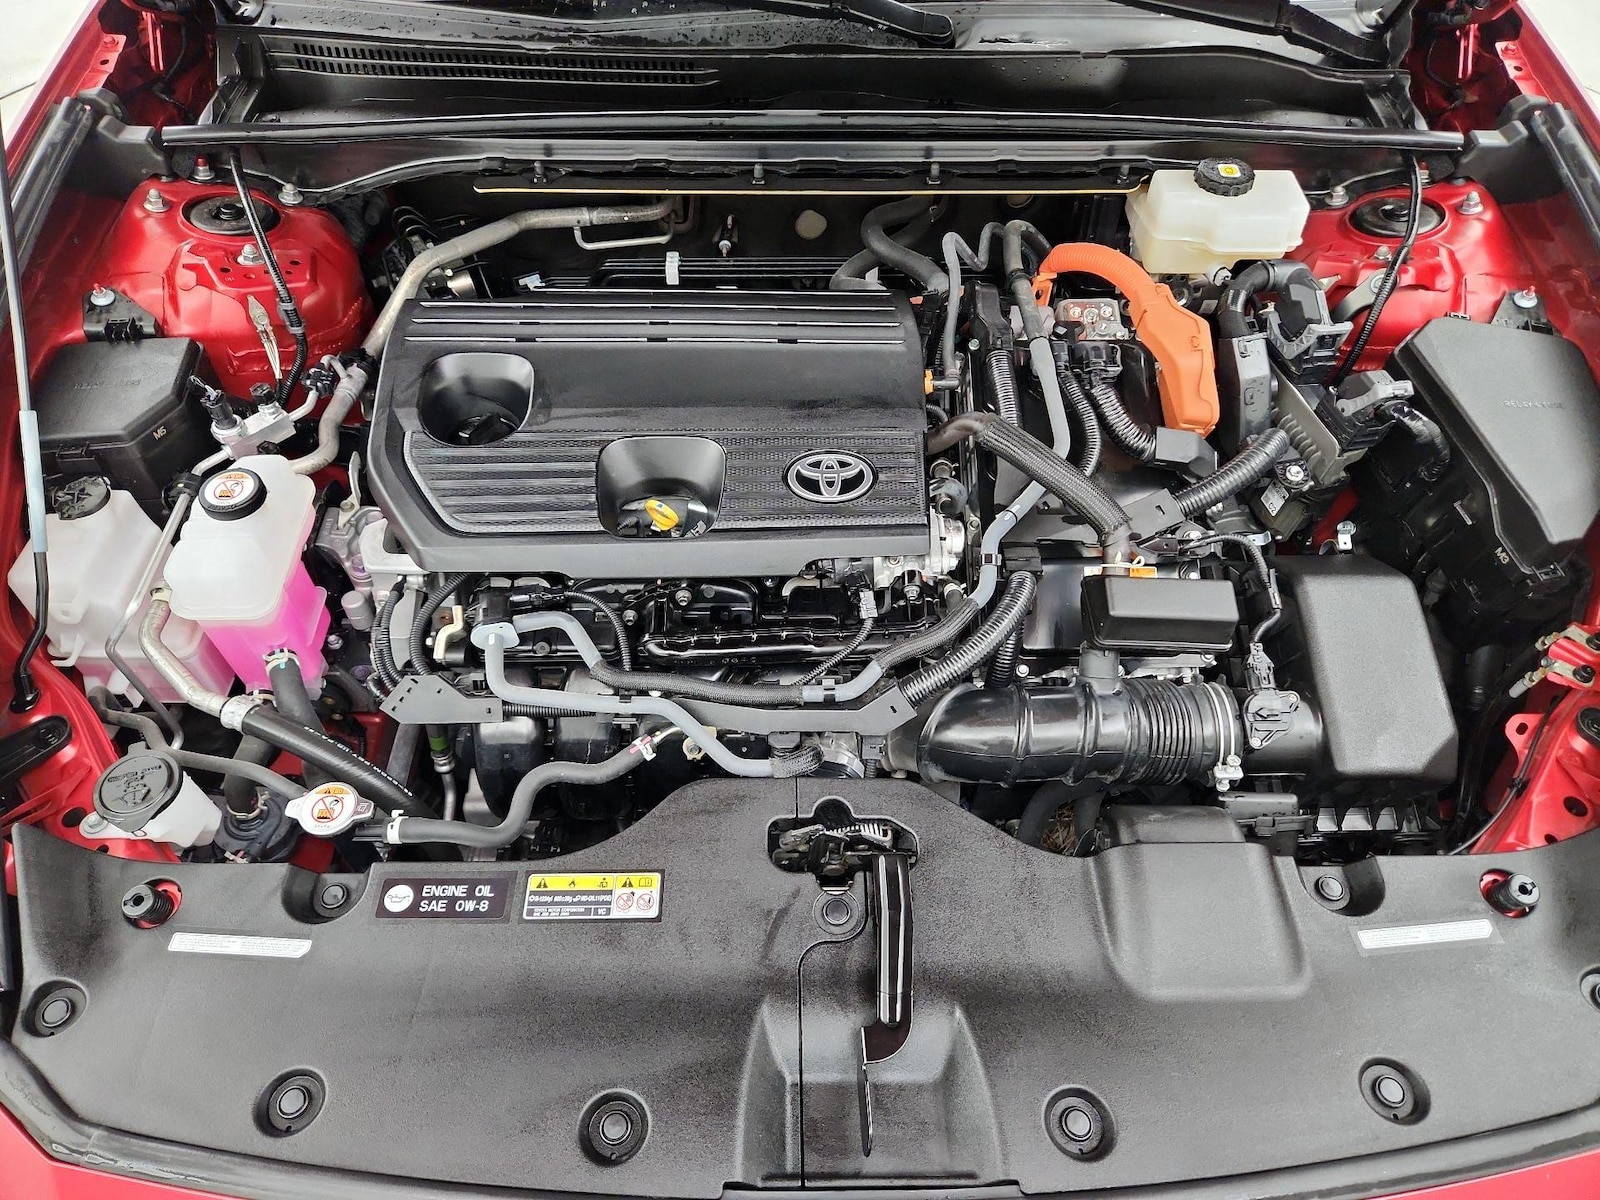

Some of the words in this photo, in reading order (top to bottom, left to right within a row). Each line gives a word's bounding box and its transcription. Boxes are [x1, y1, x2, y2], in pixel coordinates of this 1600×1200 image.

[1495, 547, 1509, 564] M3
[421, 885, 468, 897] ENGINE
[475, 885, 495, 897] OIL
[419, 900, 447, 912] SAE
